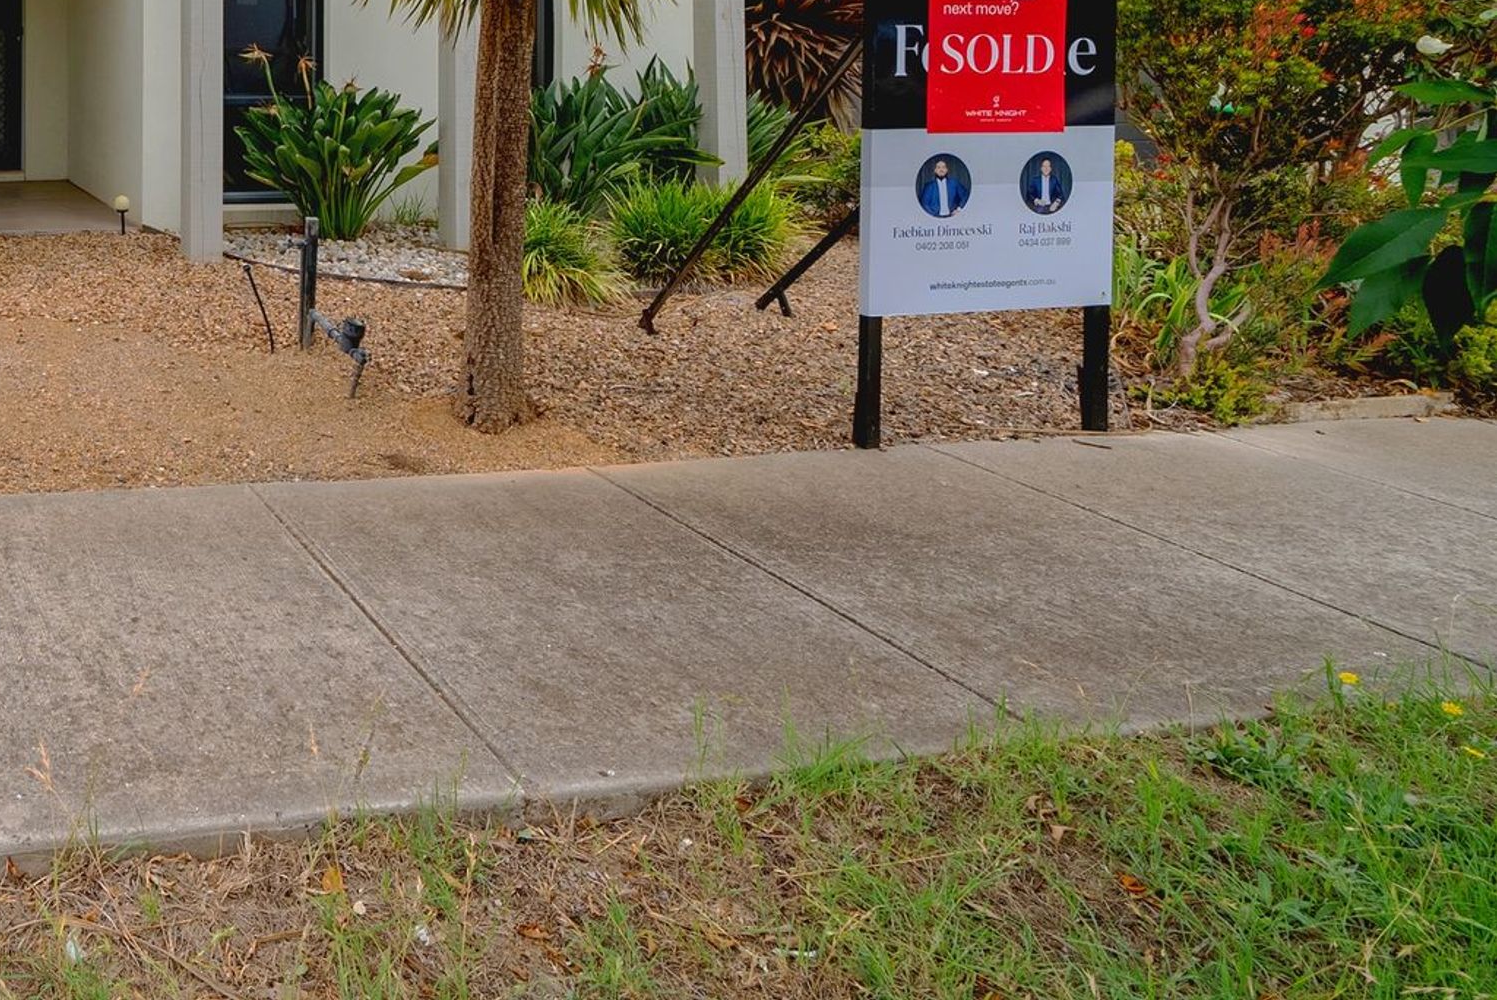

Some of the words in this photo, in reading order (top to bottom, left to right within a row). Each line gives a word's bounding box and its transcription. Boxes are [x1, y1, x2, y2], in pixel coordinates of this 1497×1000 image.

[943, 2, 972, 15] next
[975, 1, 1019, 15] move?
[940, 33, 1055, 74] SOLD
[965, 109, 992, 117] WHITE
[995, 109, 1027, 117] KNIGHT
[1019, 222, 1035, 236] Raj
[1037, 220, 1072, 233] Bakshi
